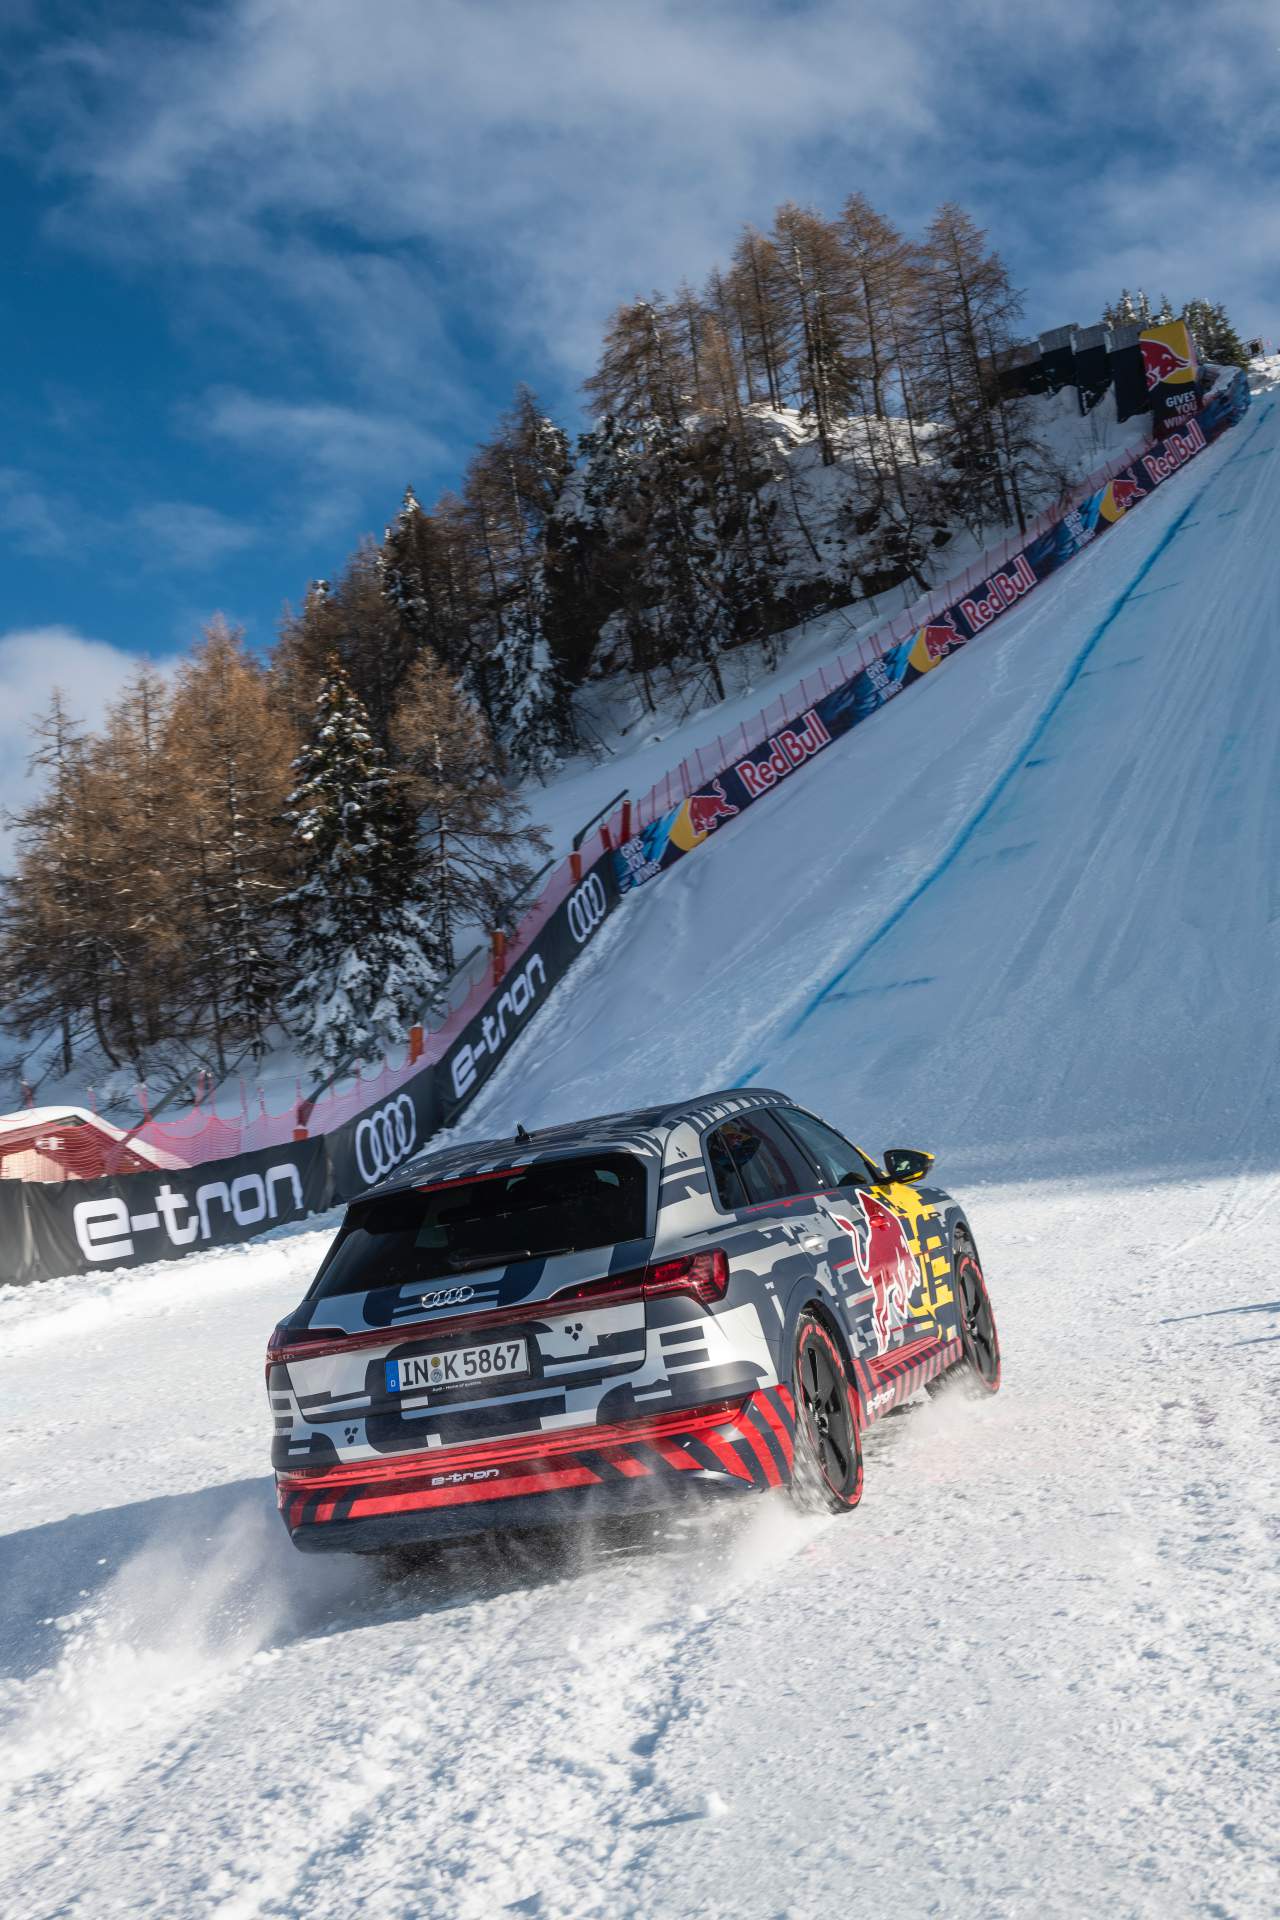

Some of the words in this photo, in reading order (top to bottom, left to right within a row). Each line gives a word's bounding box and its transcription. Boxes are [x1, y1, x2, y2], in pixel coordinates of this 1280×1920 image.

[1165, 391, 1196, 407] GIVES
[1175, 401, 1198, 415] YOU
[451, 953, 547, 1099] e-tron
[73, 1163, 304, 1261] e-tron
[402, 1359, 429, 1387] IN
[443, 1353, 460, 1380] K
[463, 1344, 520, 1376] 5867
[431, 1468, 500, 1486] e-tron
